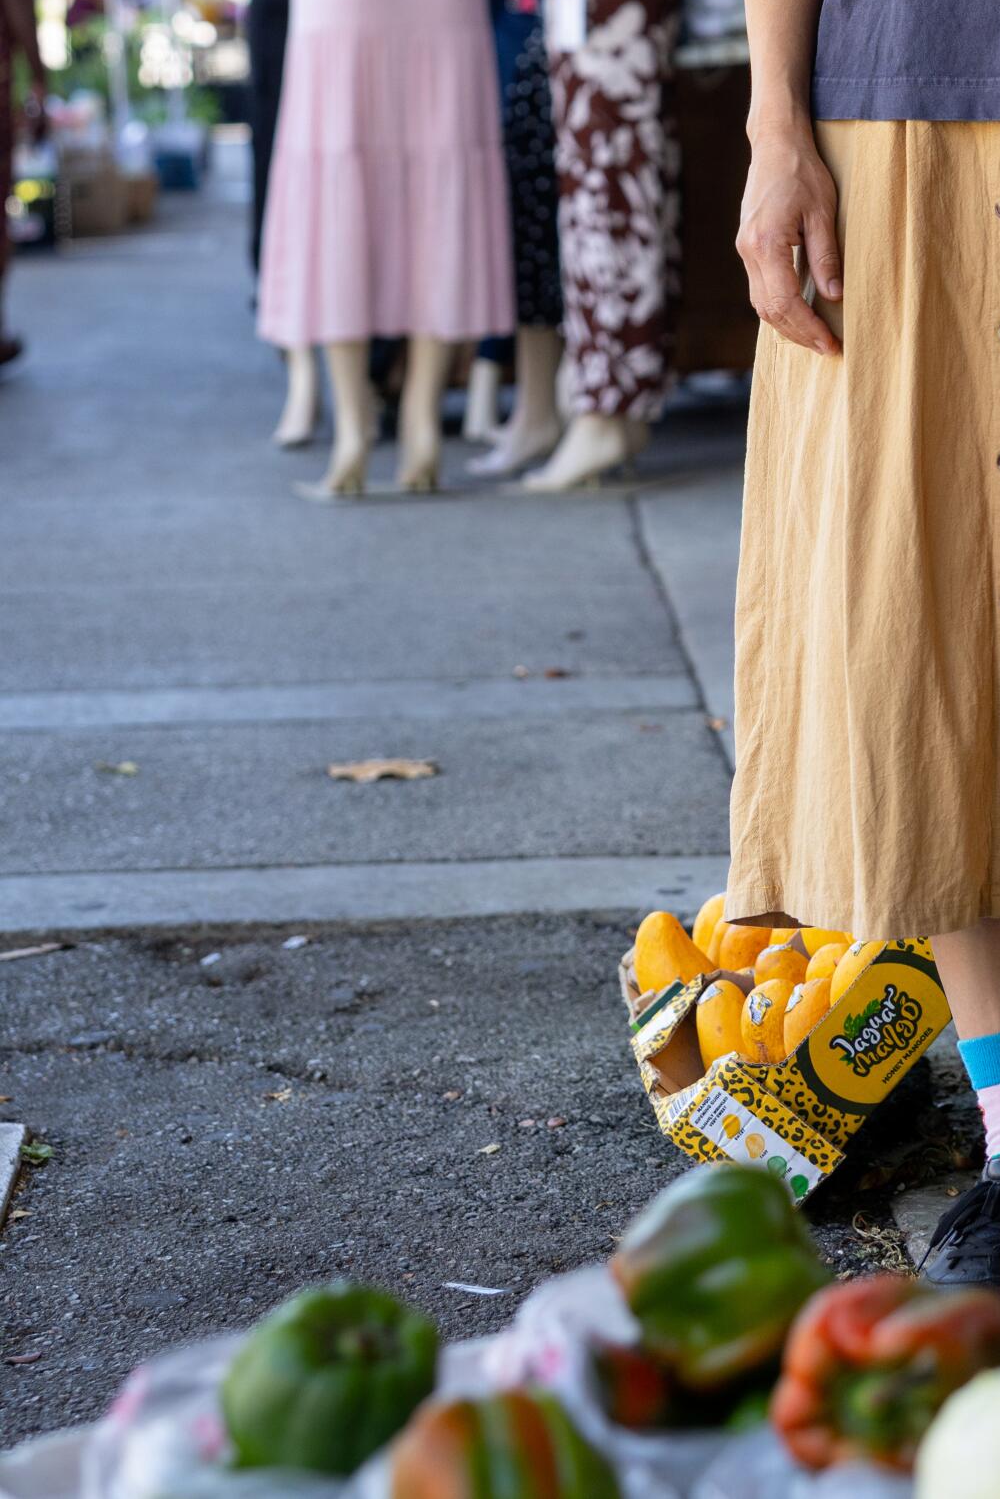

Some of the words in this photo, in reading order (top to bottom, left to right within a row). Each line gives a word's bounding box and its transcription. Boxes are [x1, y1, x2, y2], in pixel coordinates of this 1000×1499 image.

[830, 985, 898, 1060] Jaguar
[882, 1060, 905, 1084] HONEY
[904, 1027, 934, 1062] MANGOES
[697, 1096, 711, 1113] MANGO
[709, 1117, 719, 1127] VERY
[717, 1105, 728, 1120] SWEET
